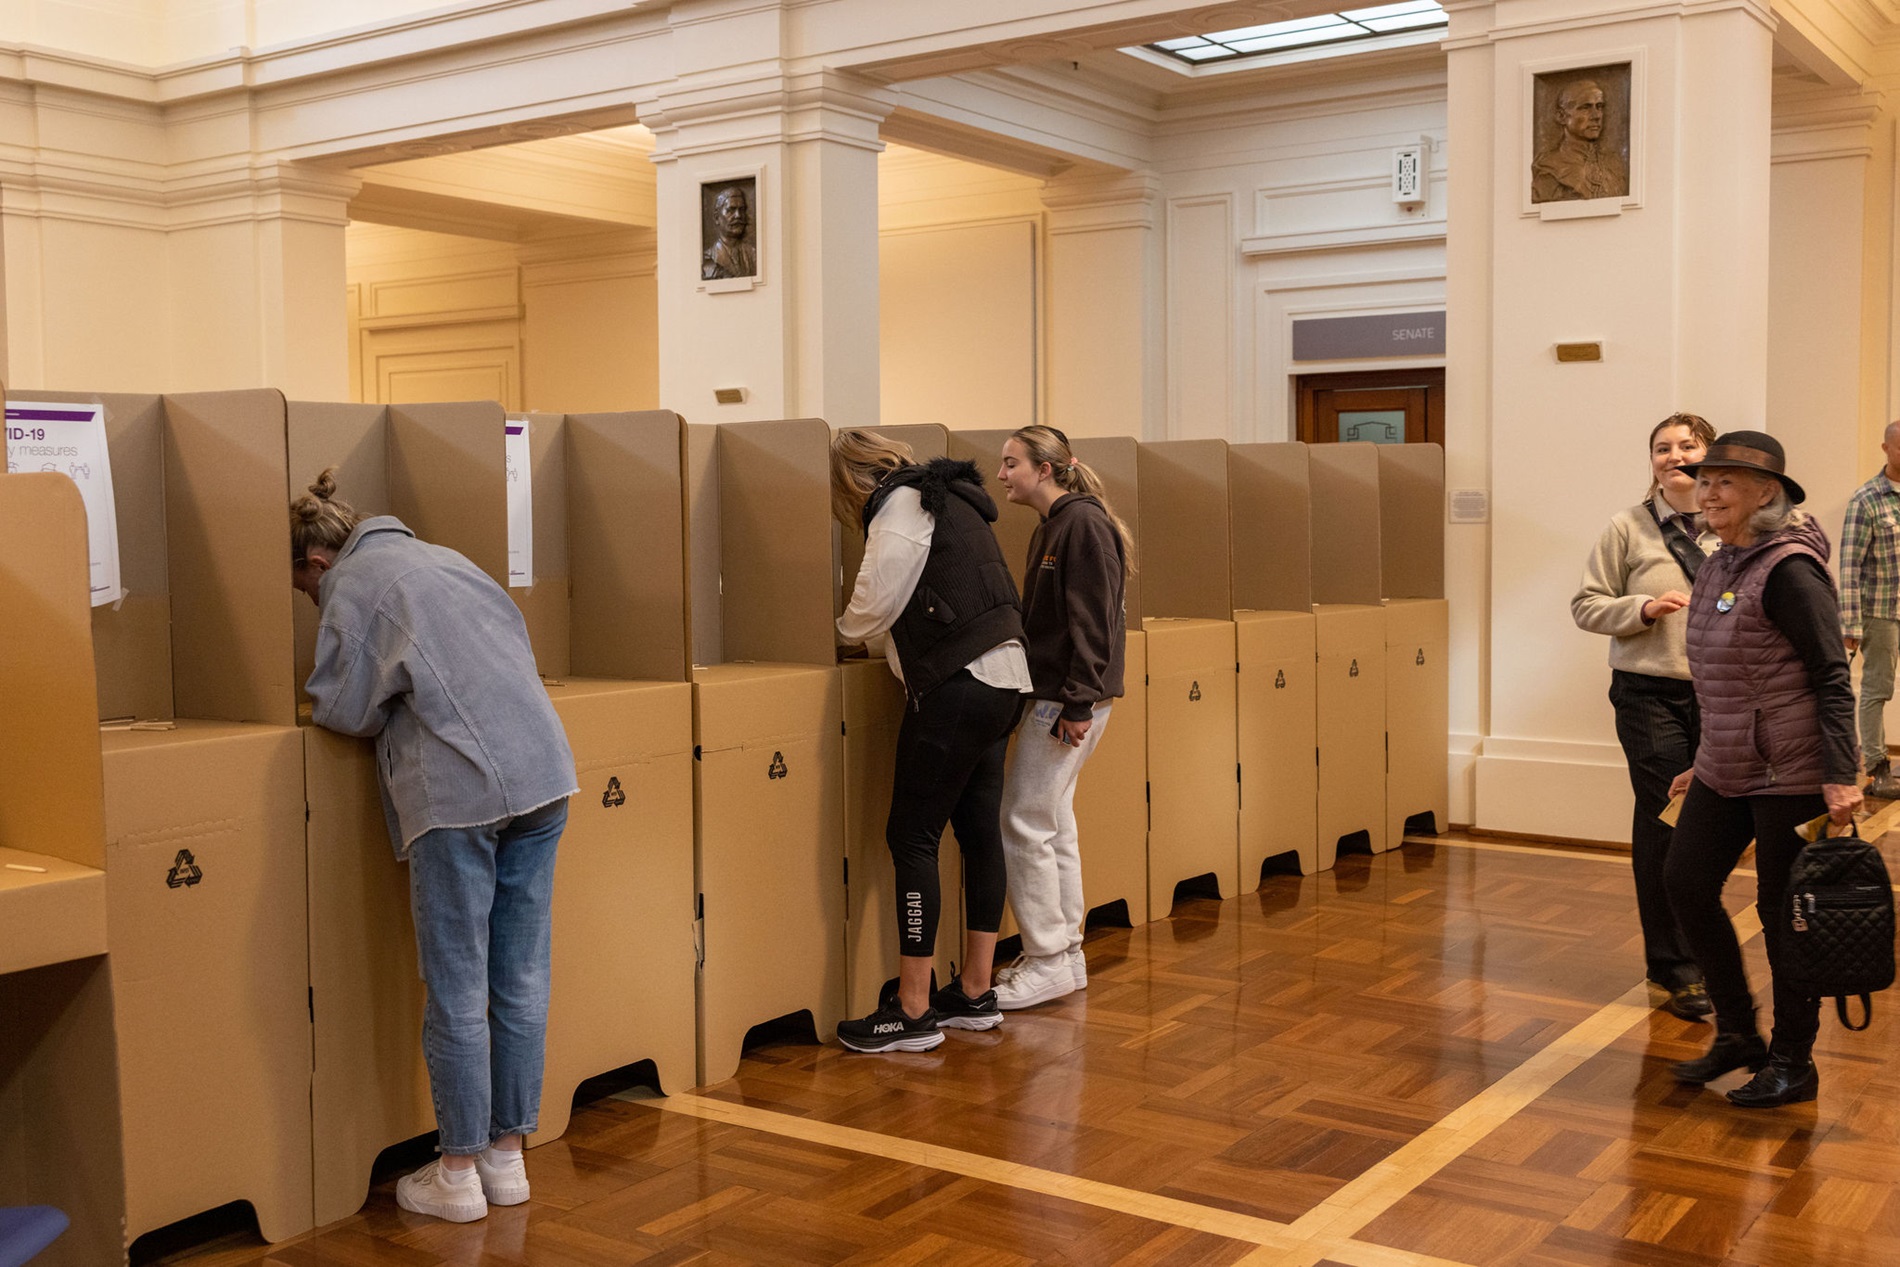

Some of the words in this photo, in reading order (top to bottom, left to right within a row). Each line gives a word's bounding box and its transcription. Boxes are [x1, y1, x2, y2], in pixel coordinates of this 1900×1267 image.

[1392, 327, 1435, 341] SENATE
[19, 445, 79, 457] measures
[906, 891, 923, 943] JAGGAD
[873, 1021, 905, 1034] HOKA
